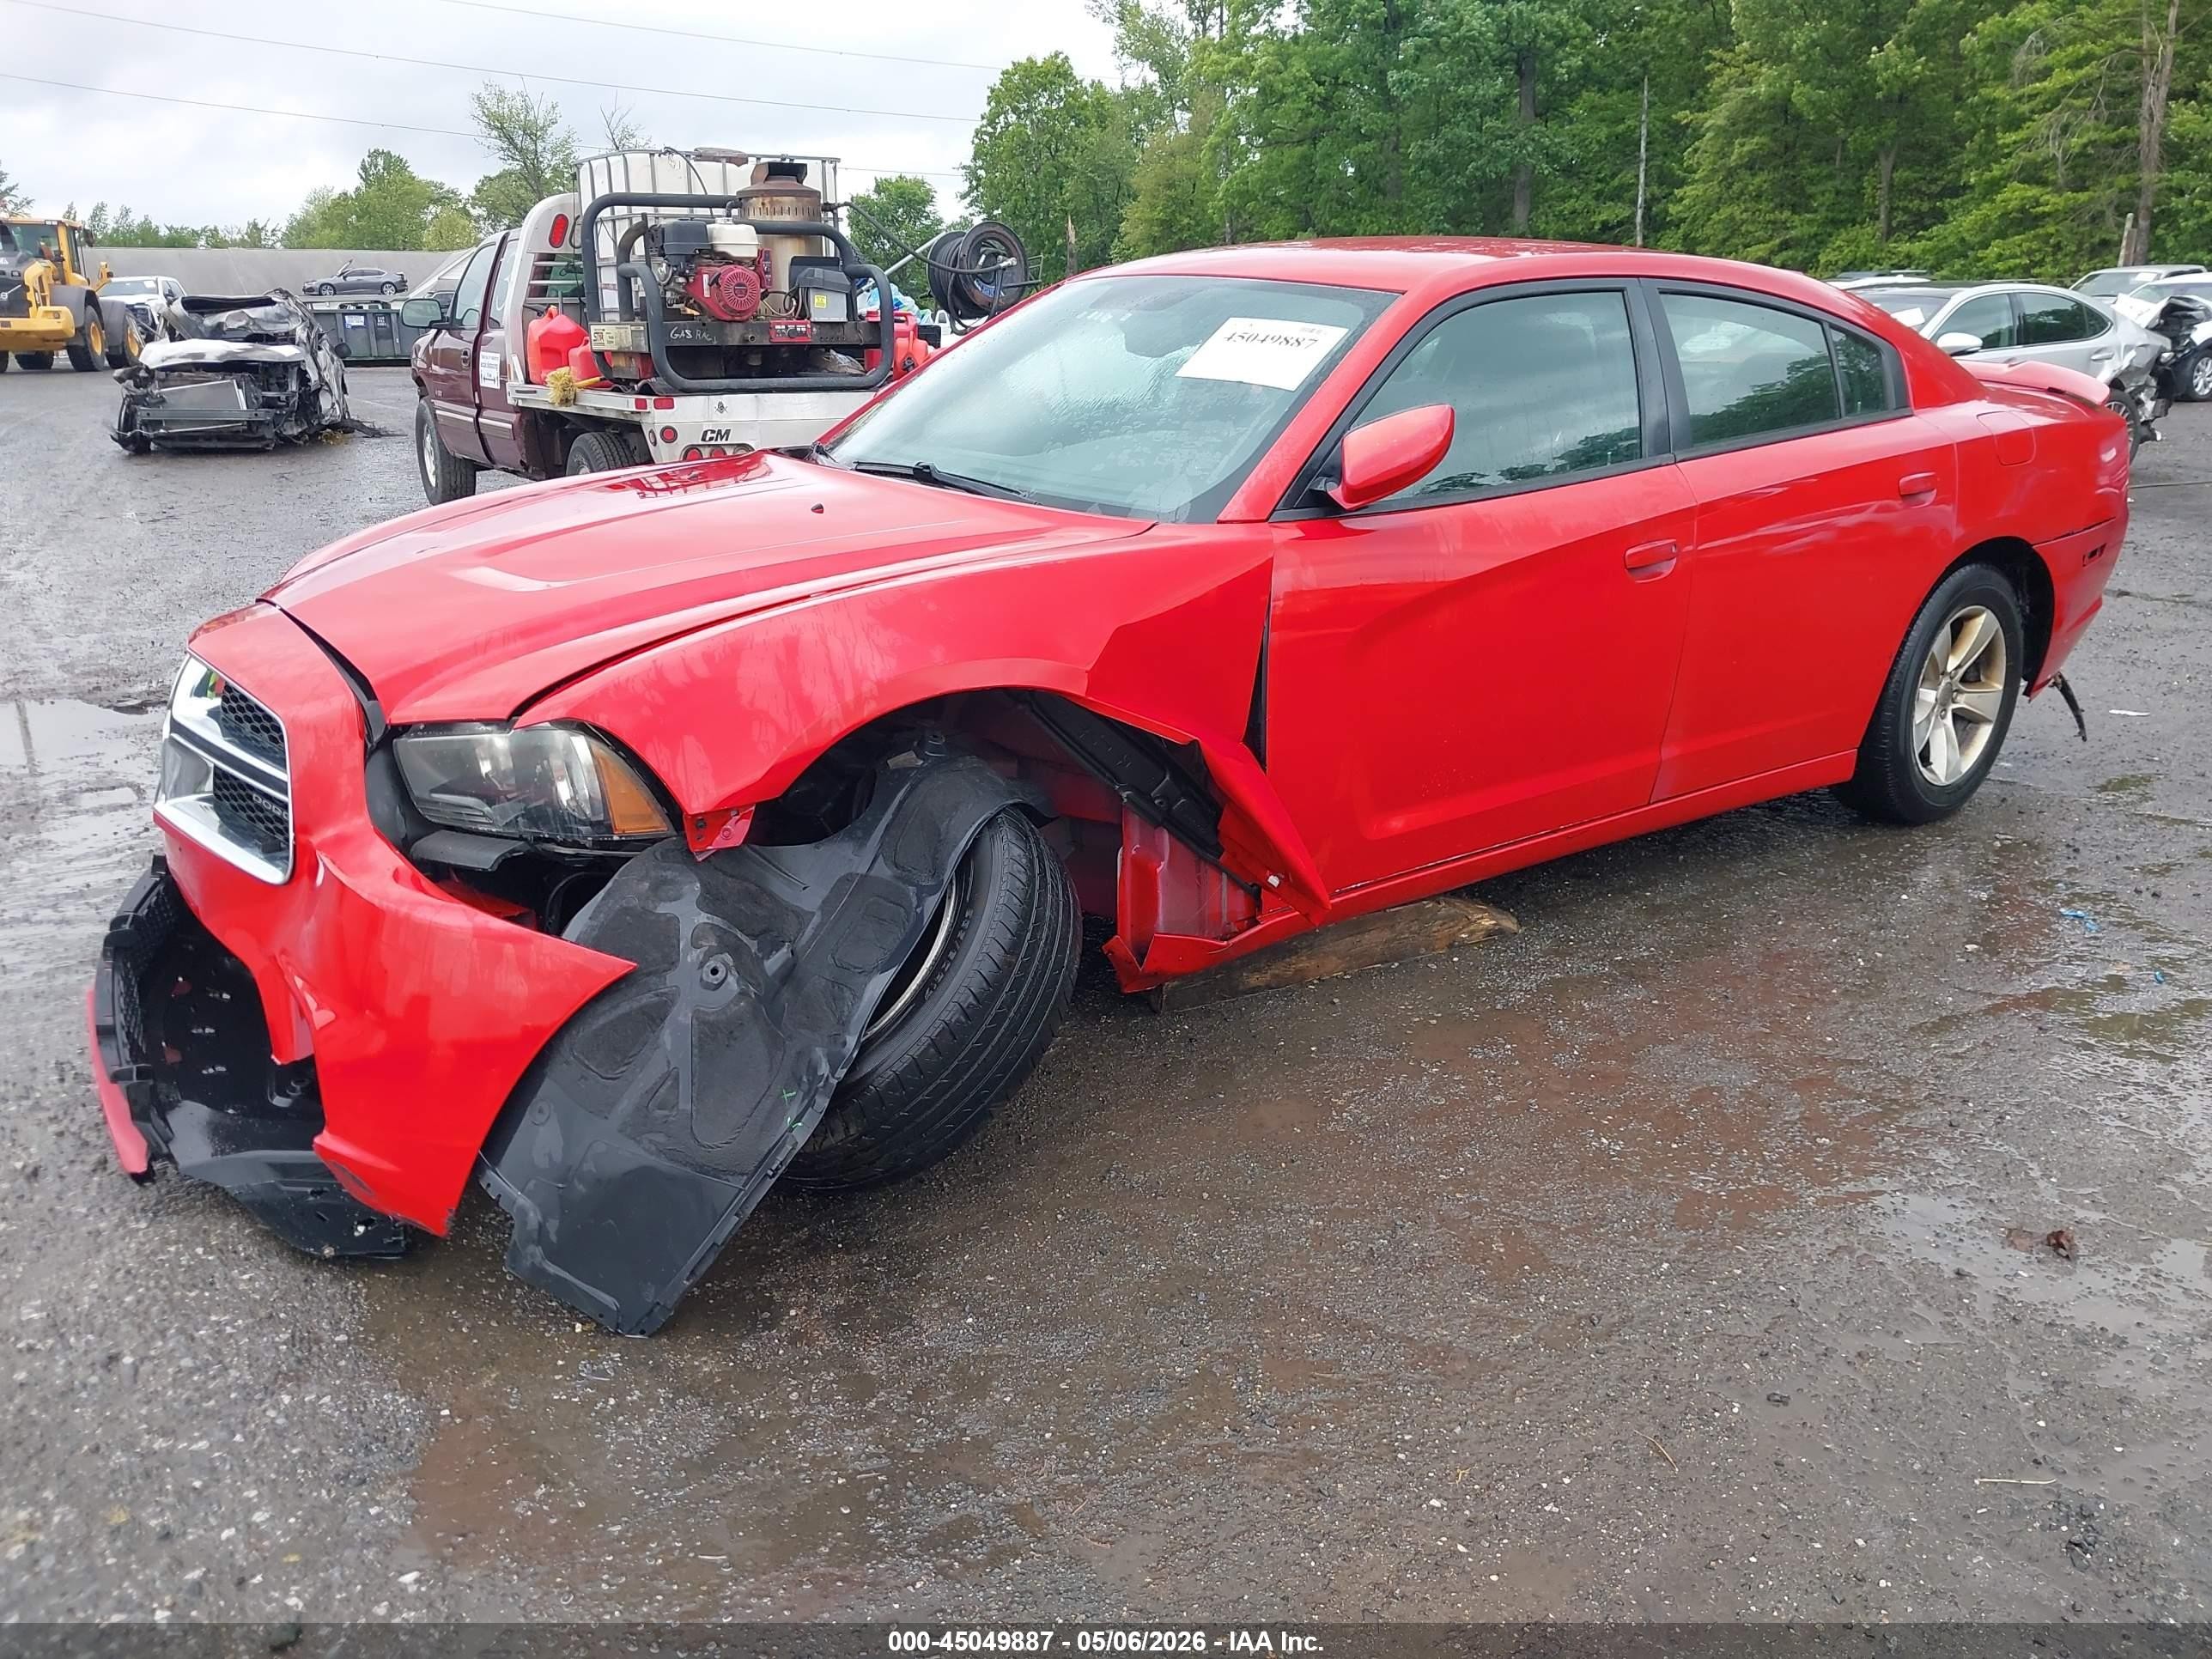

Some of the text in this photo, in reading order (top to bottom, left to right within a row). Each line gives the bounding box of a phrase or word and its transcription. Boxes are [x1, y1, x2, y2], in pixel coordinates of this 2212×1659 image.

[670, 326, 693, 339] GAS
[1224, 331, 1318, 349] 45049887
[701, 428, 731, 442] CM
[252, 793, 289, 820] DODG
